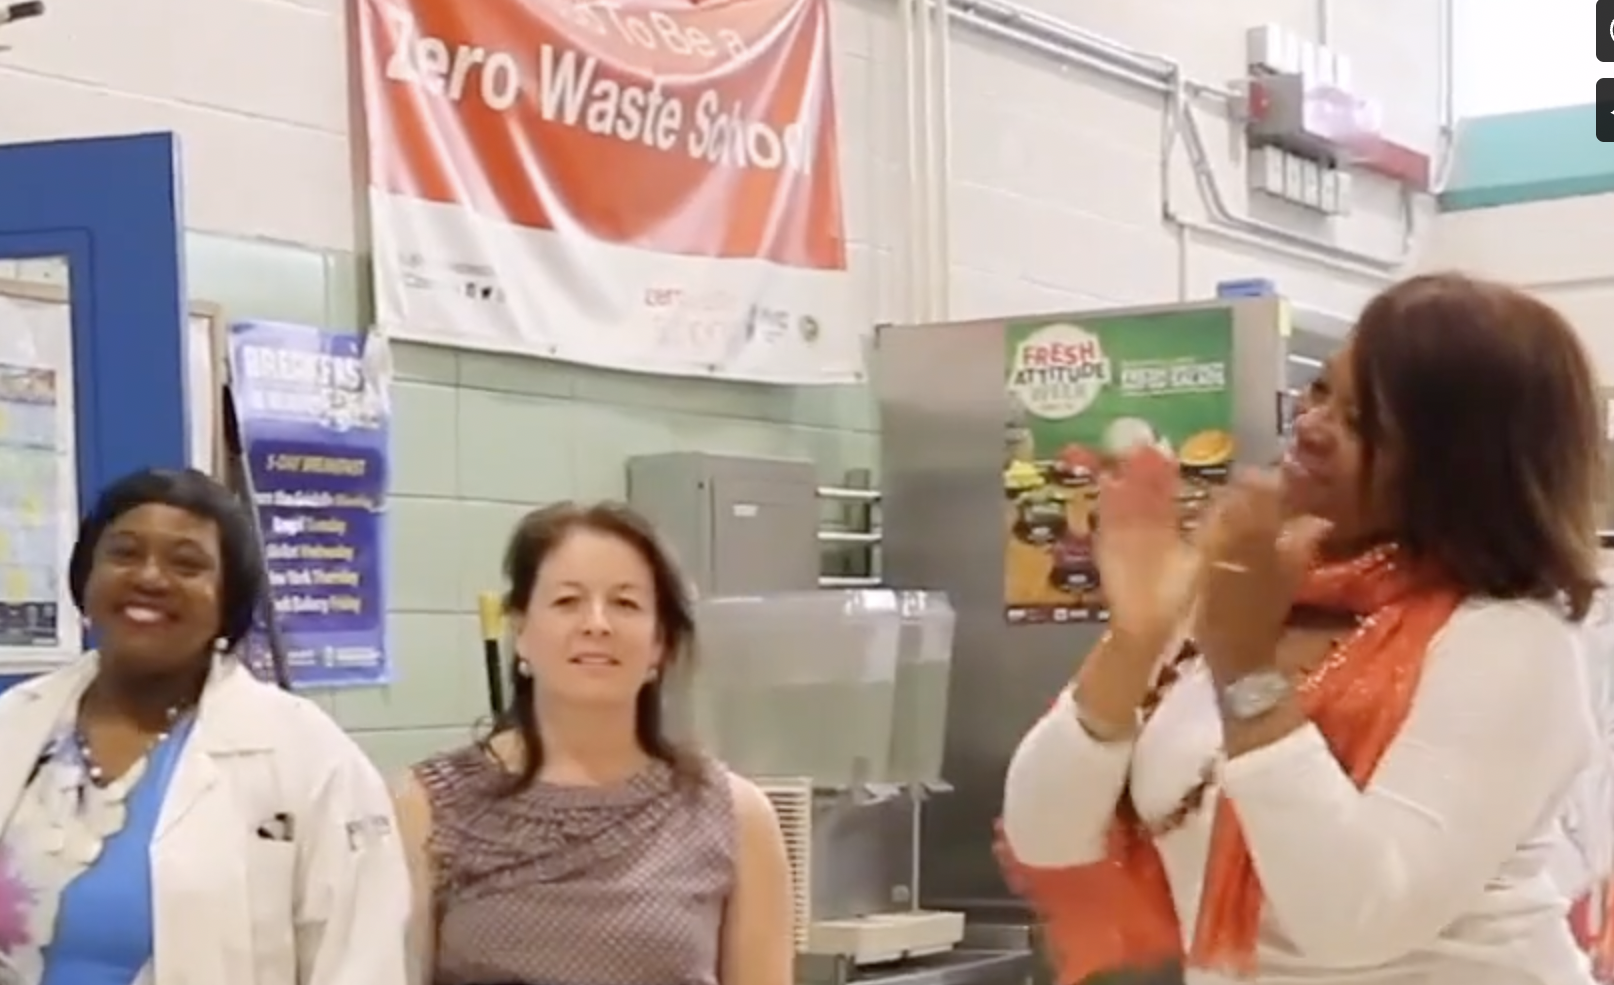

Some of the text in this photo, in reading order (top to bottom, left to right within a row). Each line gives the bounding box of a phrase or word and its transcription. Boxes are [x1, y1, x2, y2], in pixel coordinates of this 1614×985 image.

[649, 11, 717, 57] Be
[386, 8, 520, 111] Zero
[538, 44, 682, 150] Waste
[1022, 338, 1096, 366] FRESH
[1013, 361, 1106, 385] ATTITUDE
